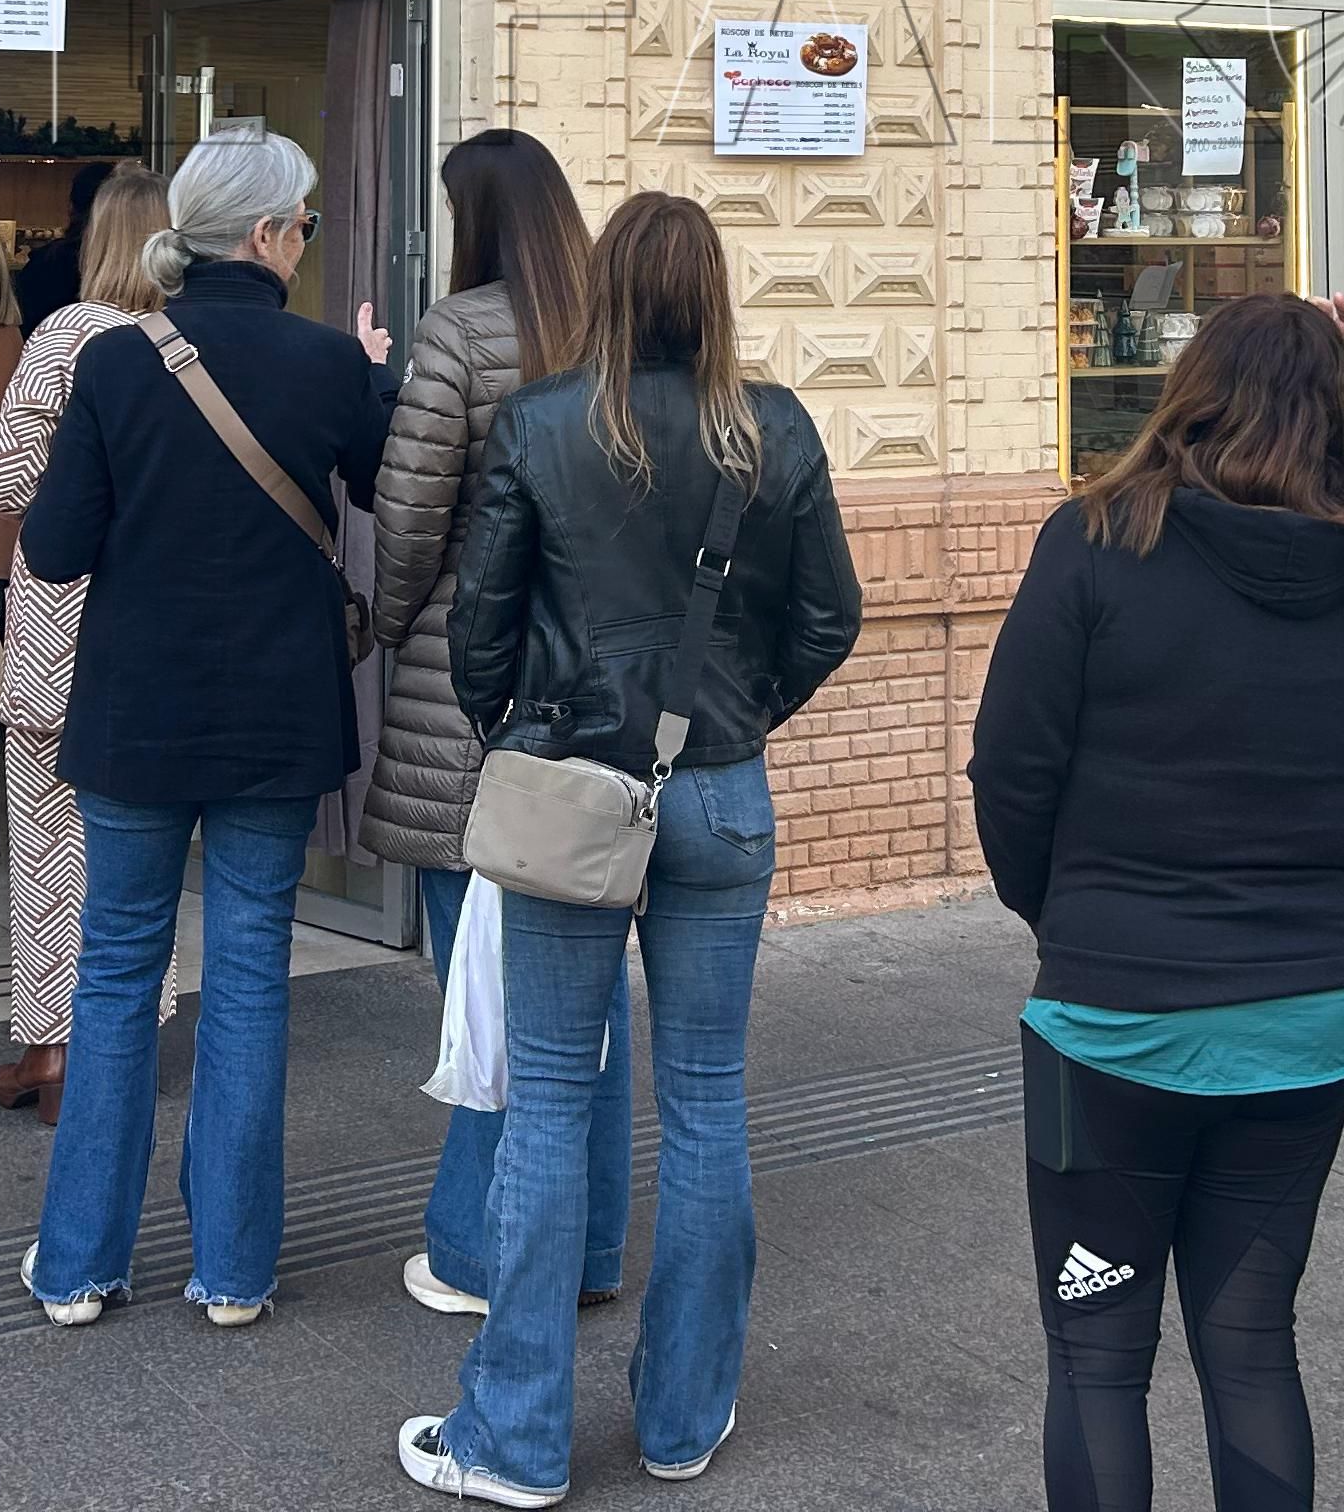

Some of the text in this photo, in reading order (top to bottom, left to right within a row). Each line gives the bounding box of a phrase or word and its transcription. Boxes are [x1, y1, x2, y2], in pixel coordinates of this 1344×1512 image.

[723, 47, 791, 61] La Royal
[1057, 1264, 1136, 1301] adidas
